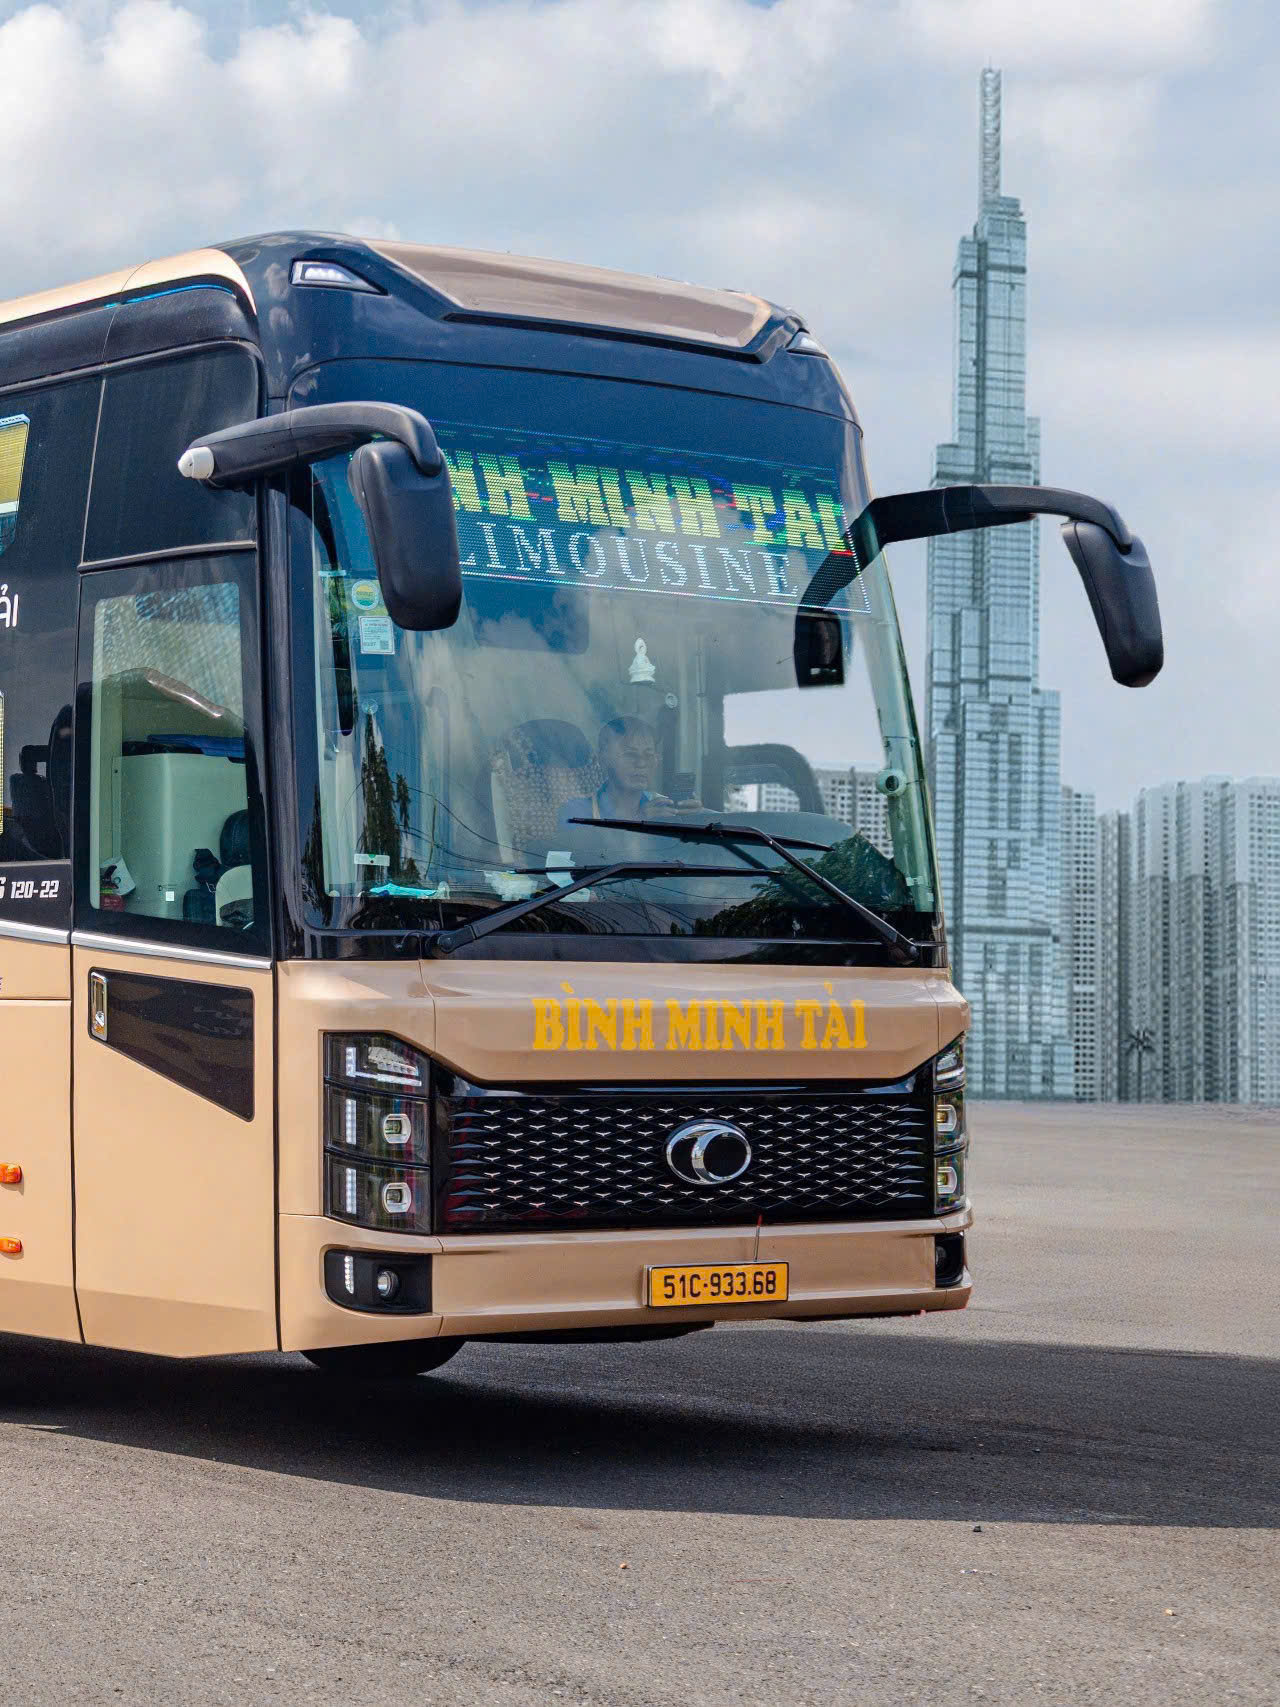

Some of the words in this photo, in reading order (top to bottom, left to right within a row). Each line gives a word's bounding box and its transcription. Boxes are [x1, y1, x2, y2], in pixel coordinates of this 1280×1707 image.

[547, 461, 720, 538] MINH
[532, 980, 655, 1051] BÌNH
[665, 998, 786, 1051] MINH
